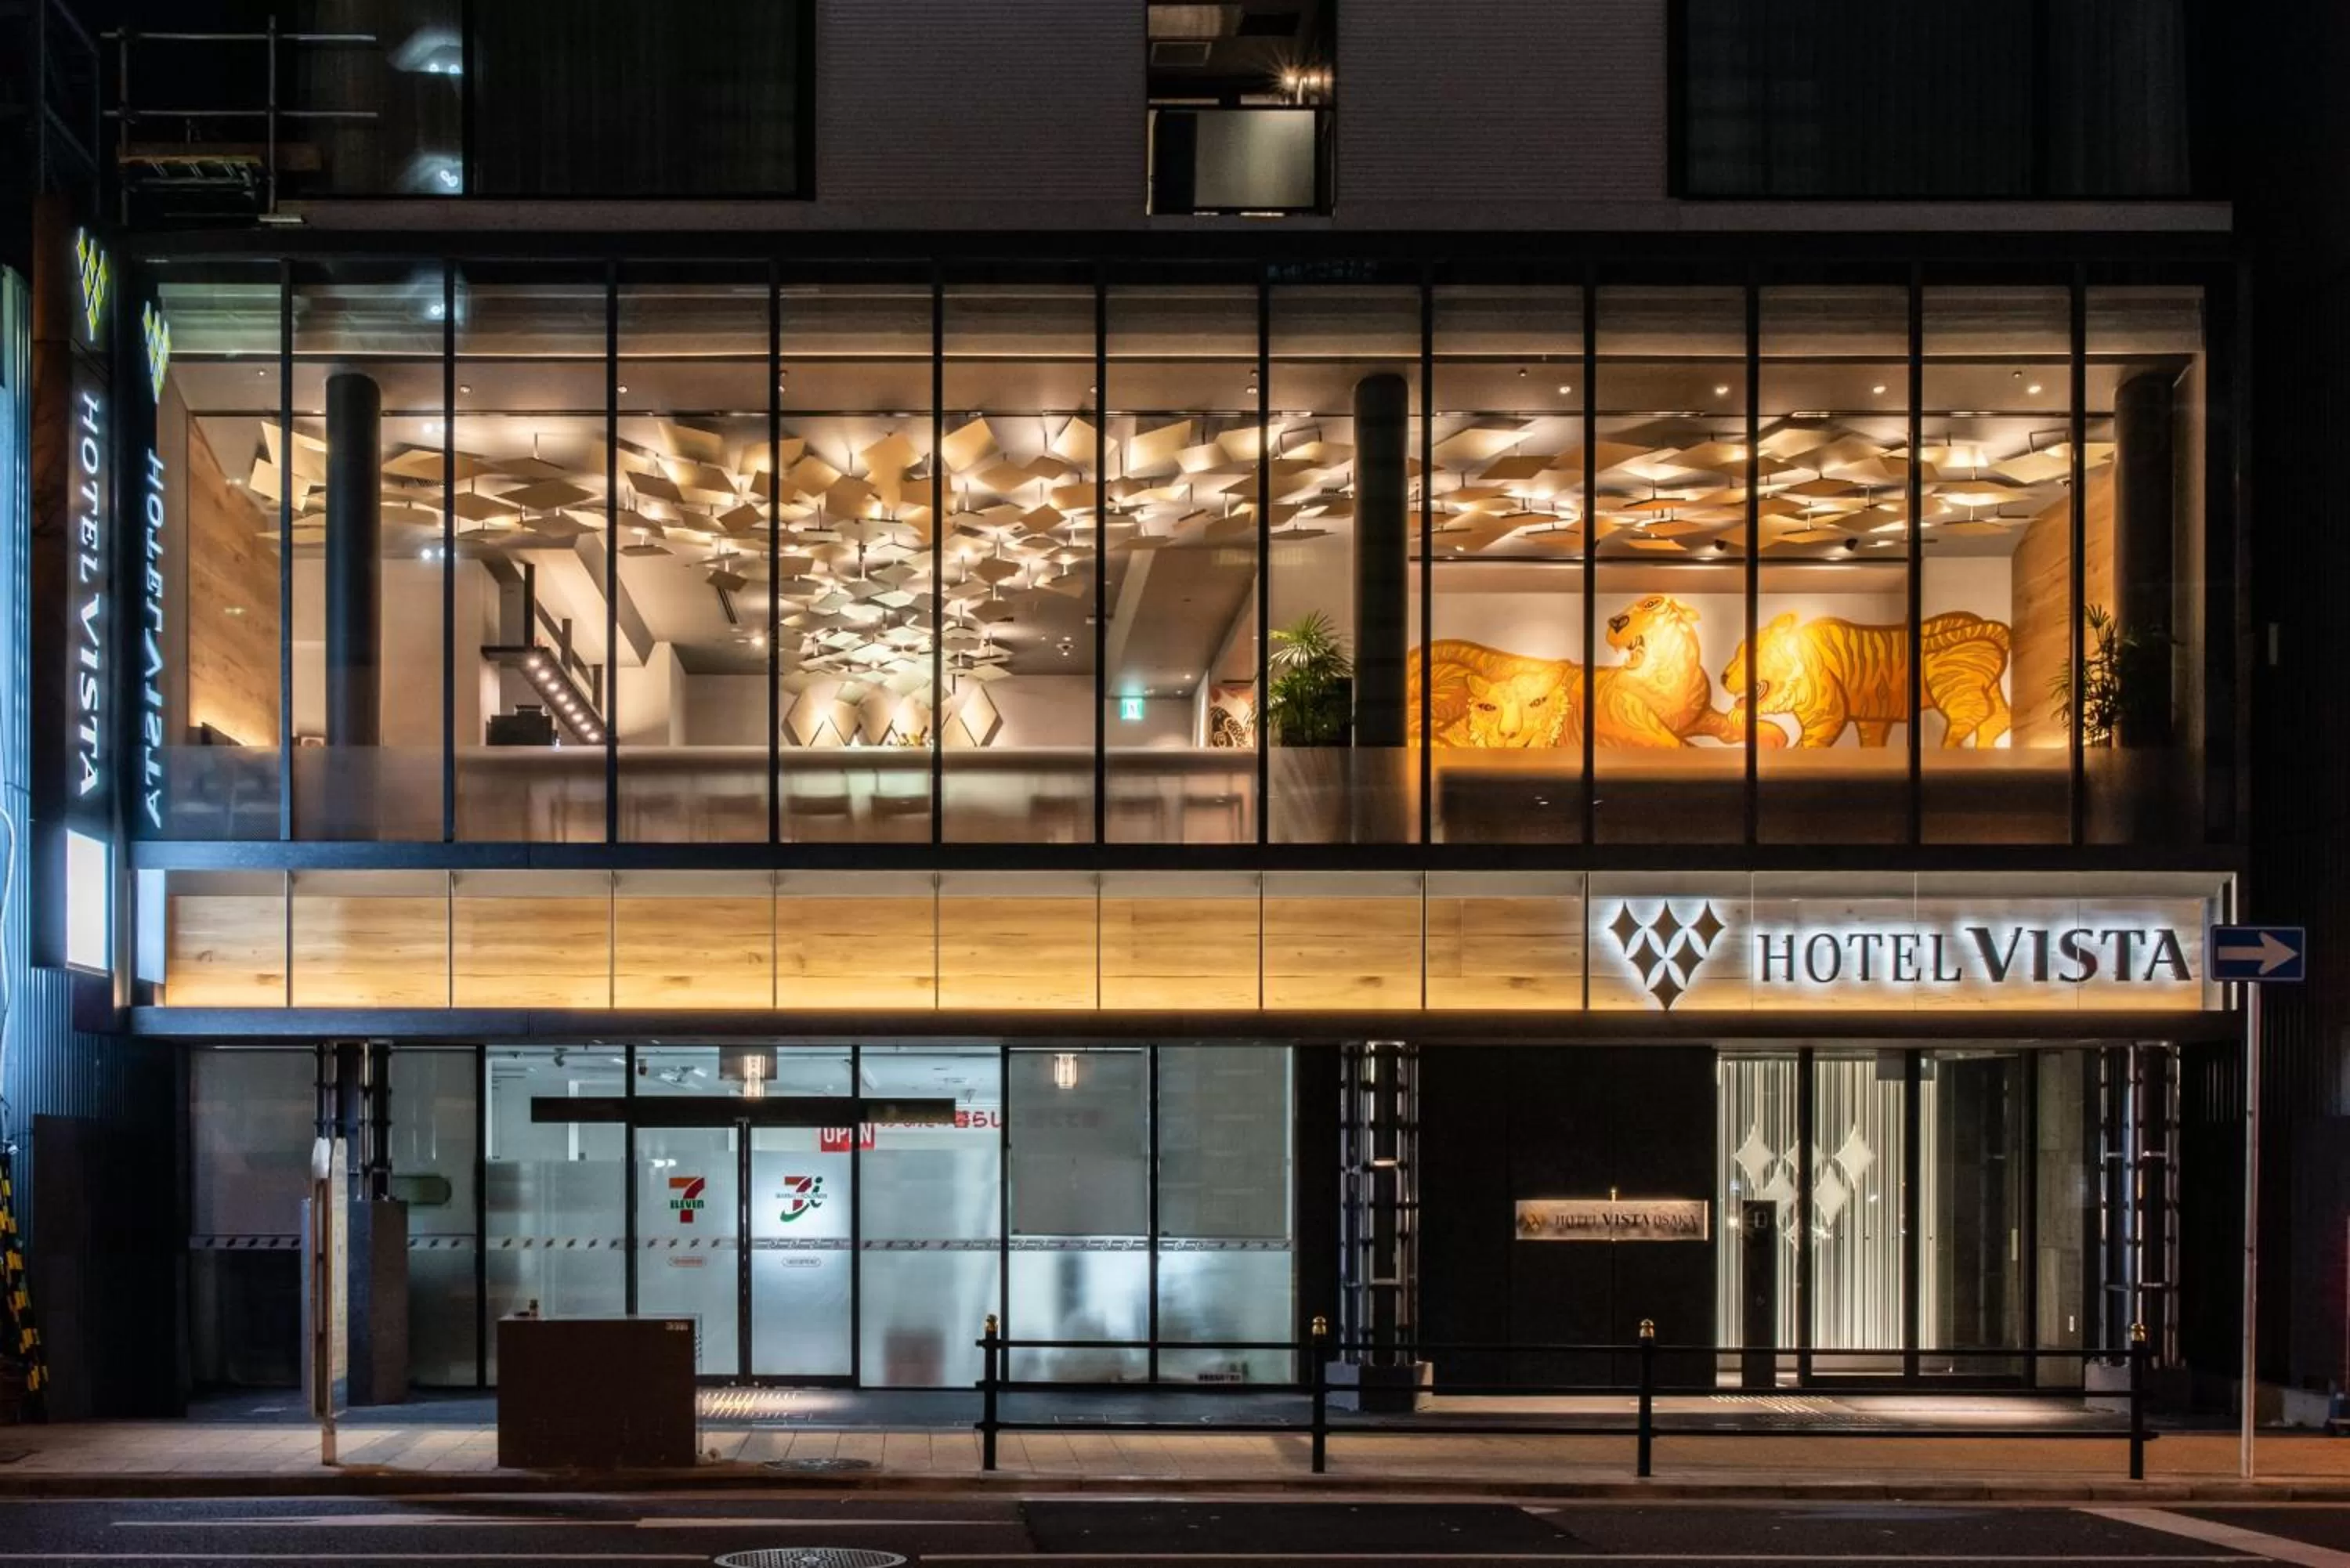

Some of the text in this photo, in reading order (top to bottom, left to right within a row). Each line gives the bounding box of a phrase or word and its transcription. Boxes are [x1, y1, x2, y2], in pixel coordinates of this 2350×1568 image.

[80, 392, 100, 796] HOTEL VISTA
[1757, 927, 2193, 983] HOTEL VISTA
[1601, 1213, 1650, 1227] VISTA
